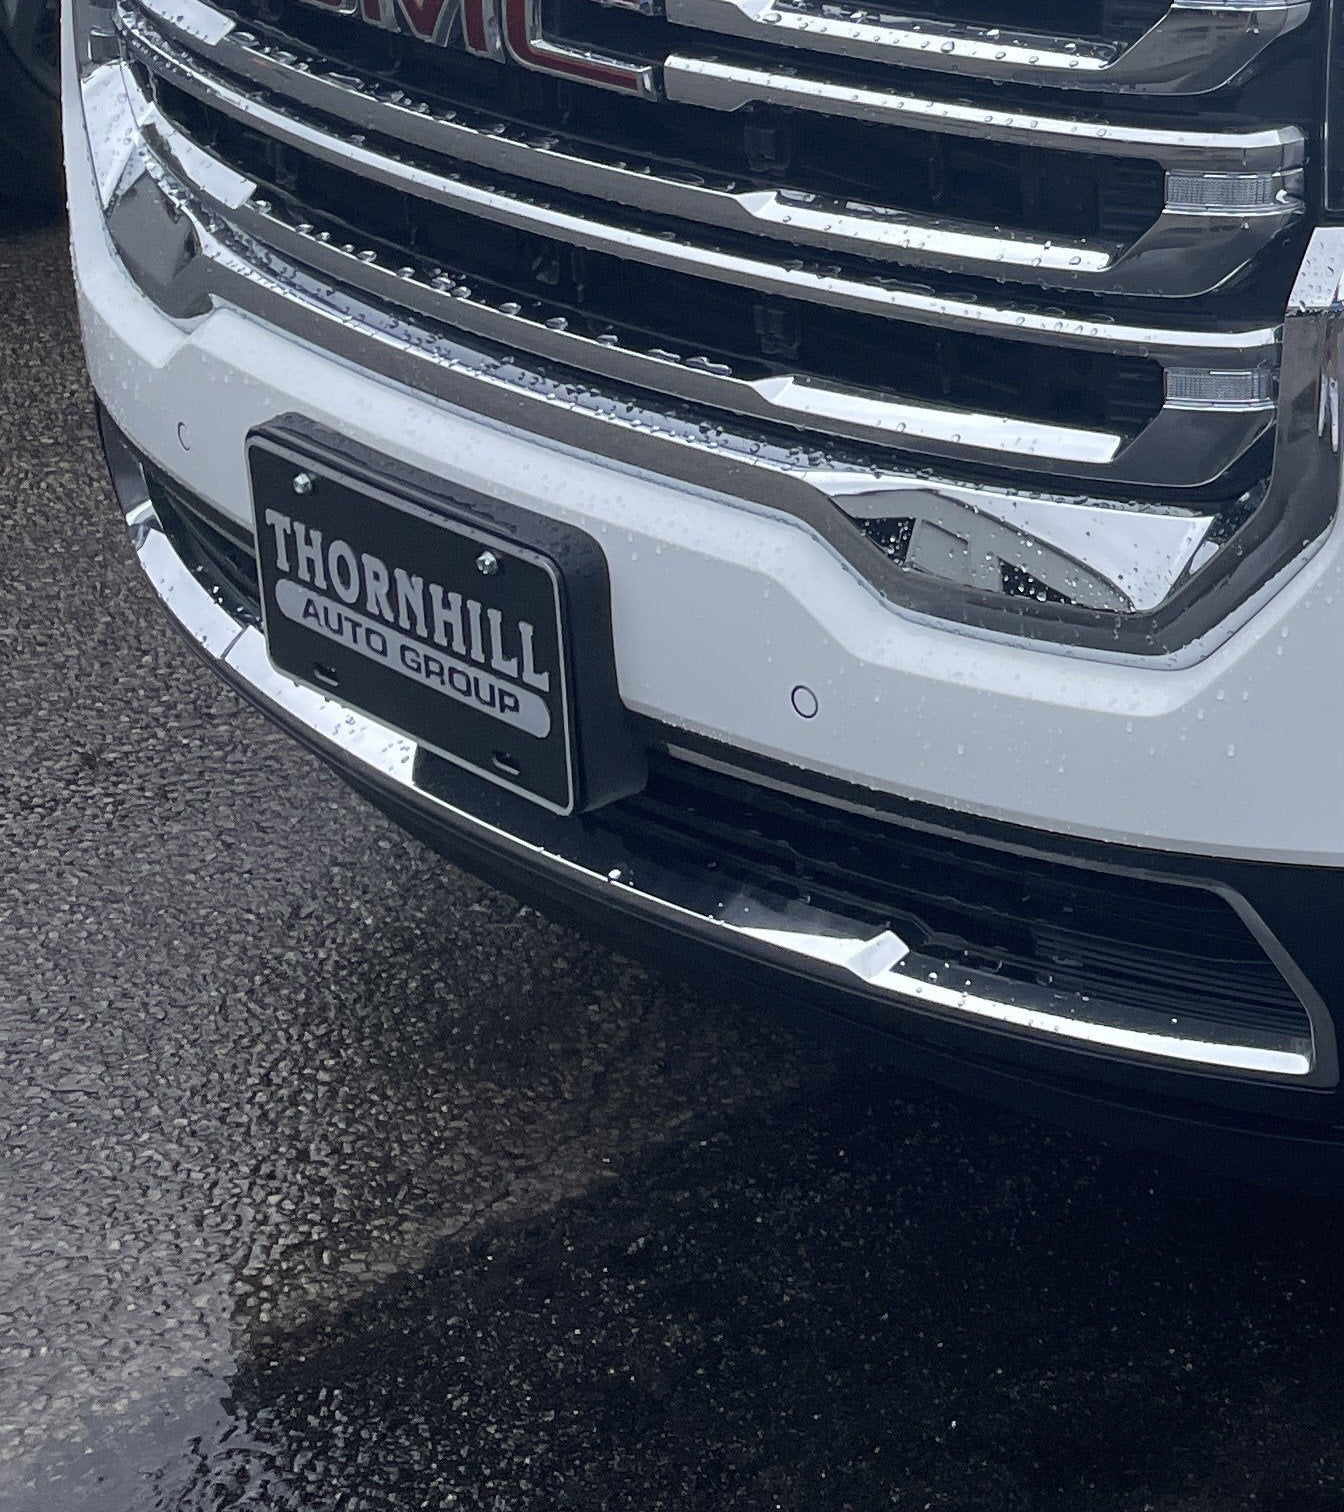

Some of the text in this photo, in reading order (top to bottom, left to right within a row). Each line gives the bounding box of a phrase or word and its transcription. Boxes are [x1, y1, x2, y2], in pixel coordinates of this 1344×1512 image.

[265, 508, 550, 692] THORNHILL
[302, 597, 520, 715] AUTO GROUP
